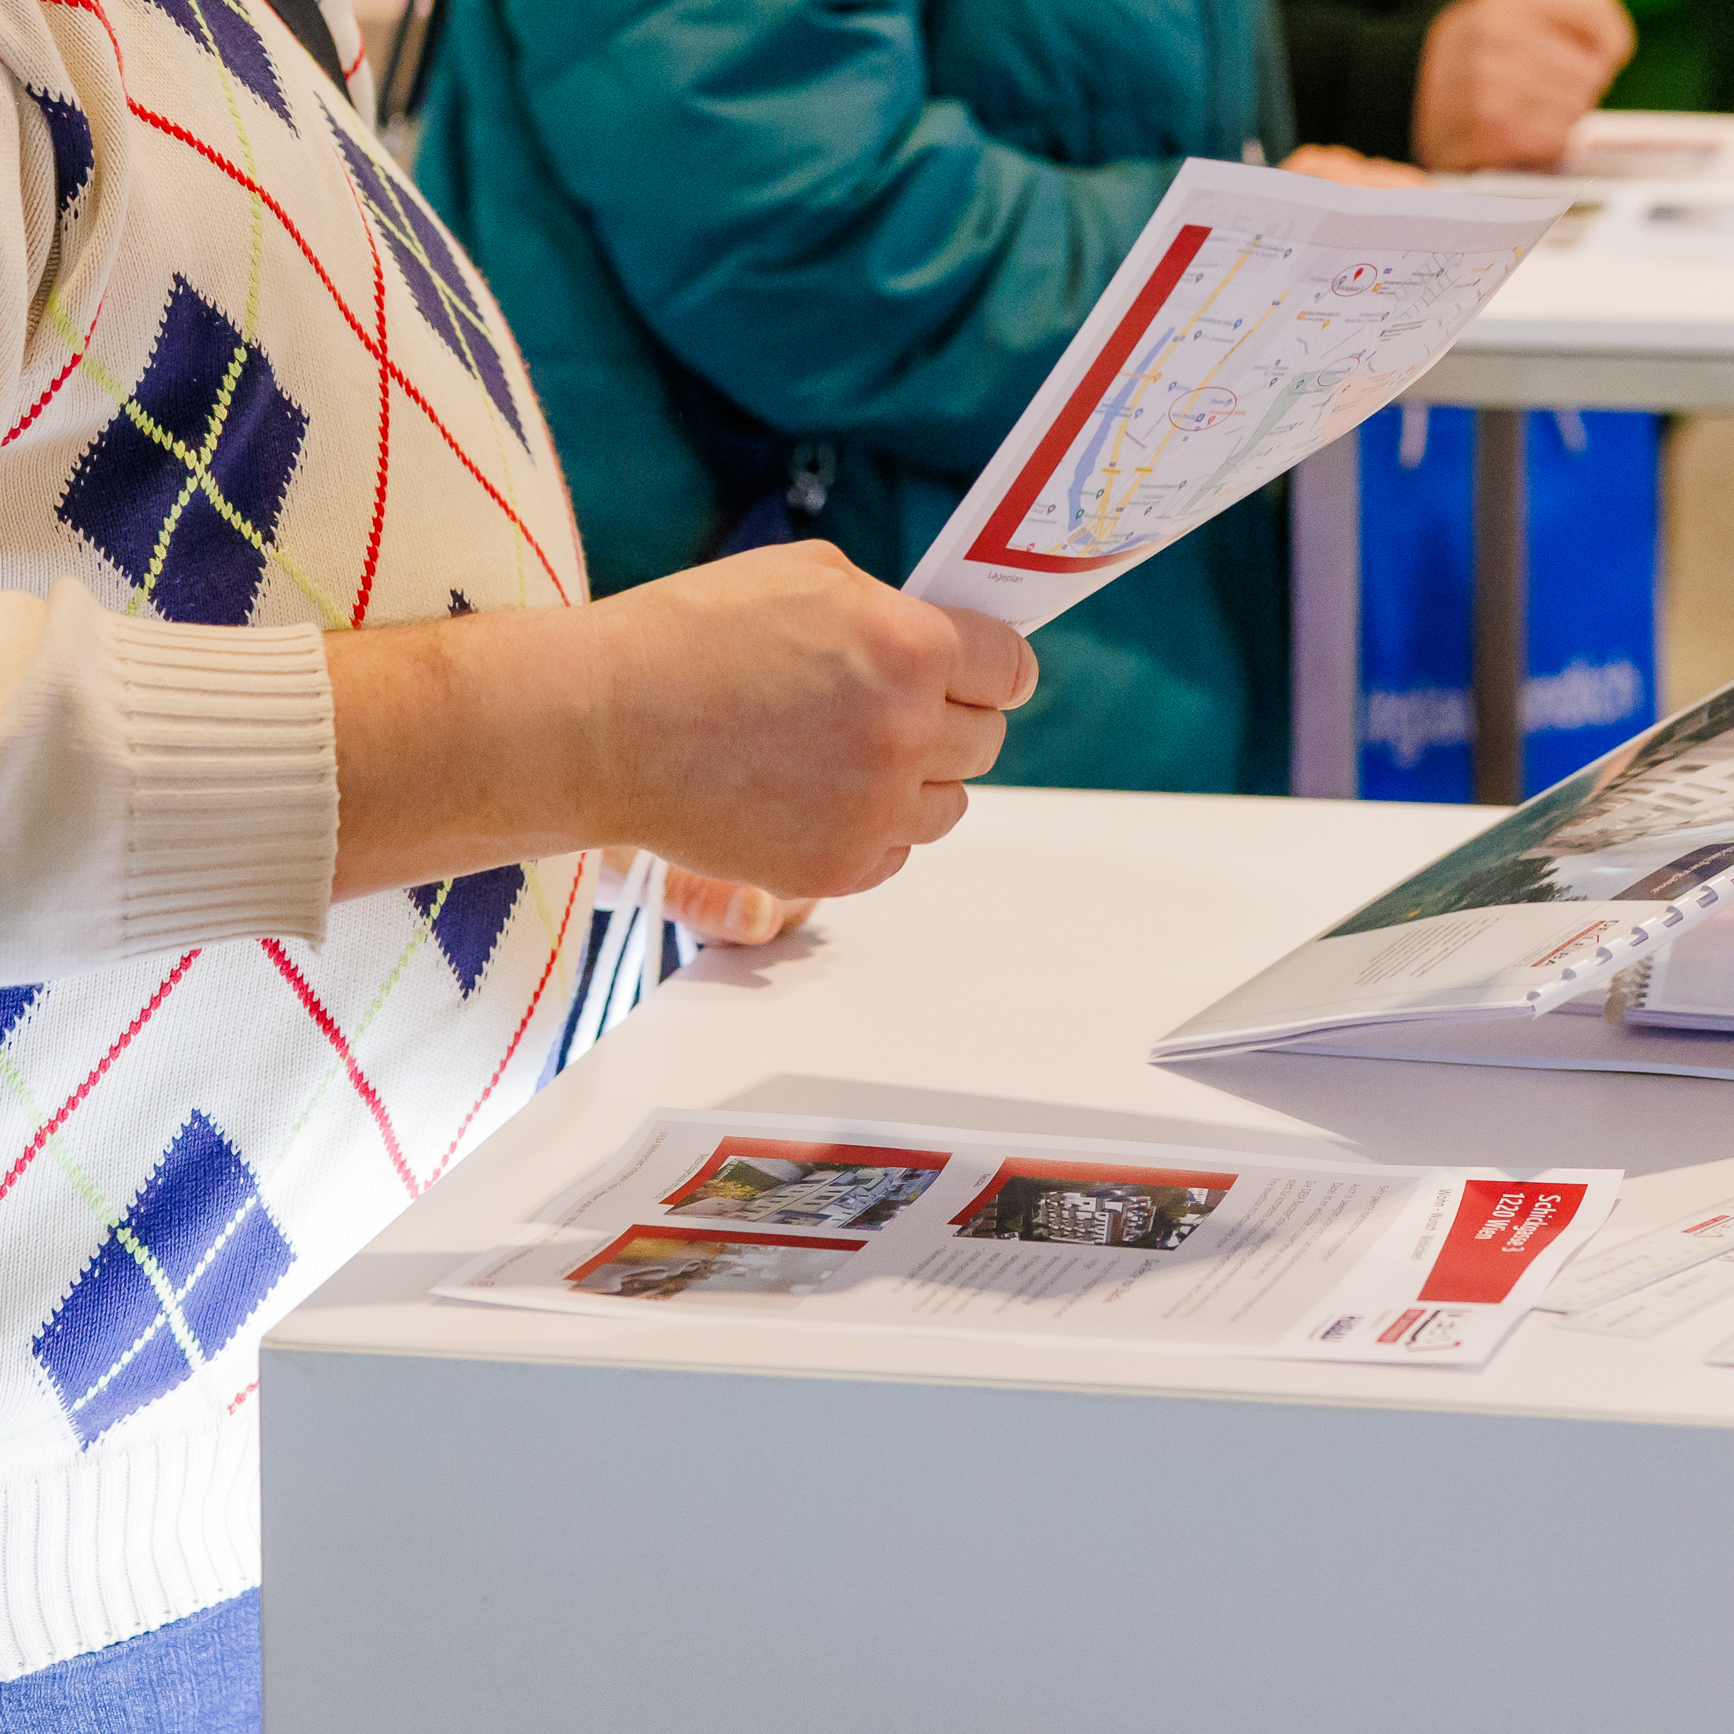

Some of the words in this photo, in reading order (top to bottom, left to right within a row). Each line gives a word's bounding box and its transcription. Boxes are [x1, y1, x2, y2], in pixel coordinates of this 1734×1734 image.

[987, 570, 1024, 584] Lageplan
[1492, 1192, 1525, 1218] 1220
[1474, 1219, 1511, 1240] Wien
[1506, 1194, 1561, 1246] Schickgasse
